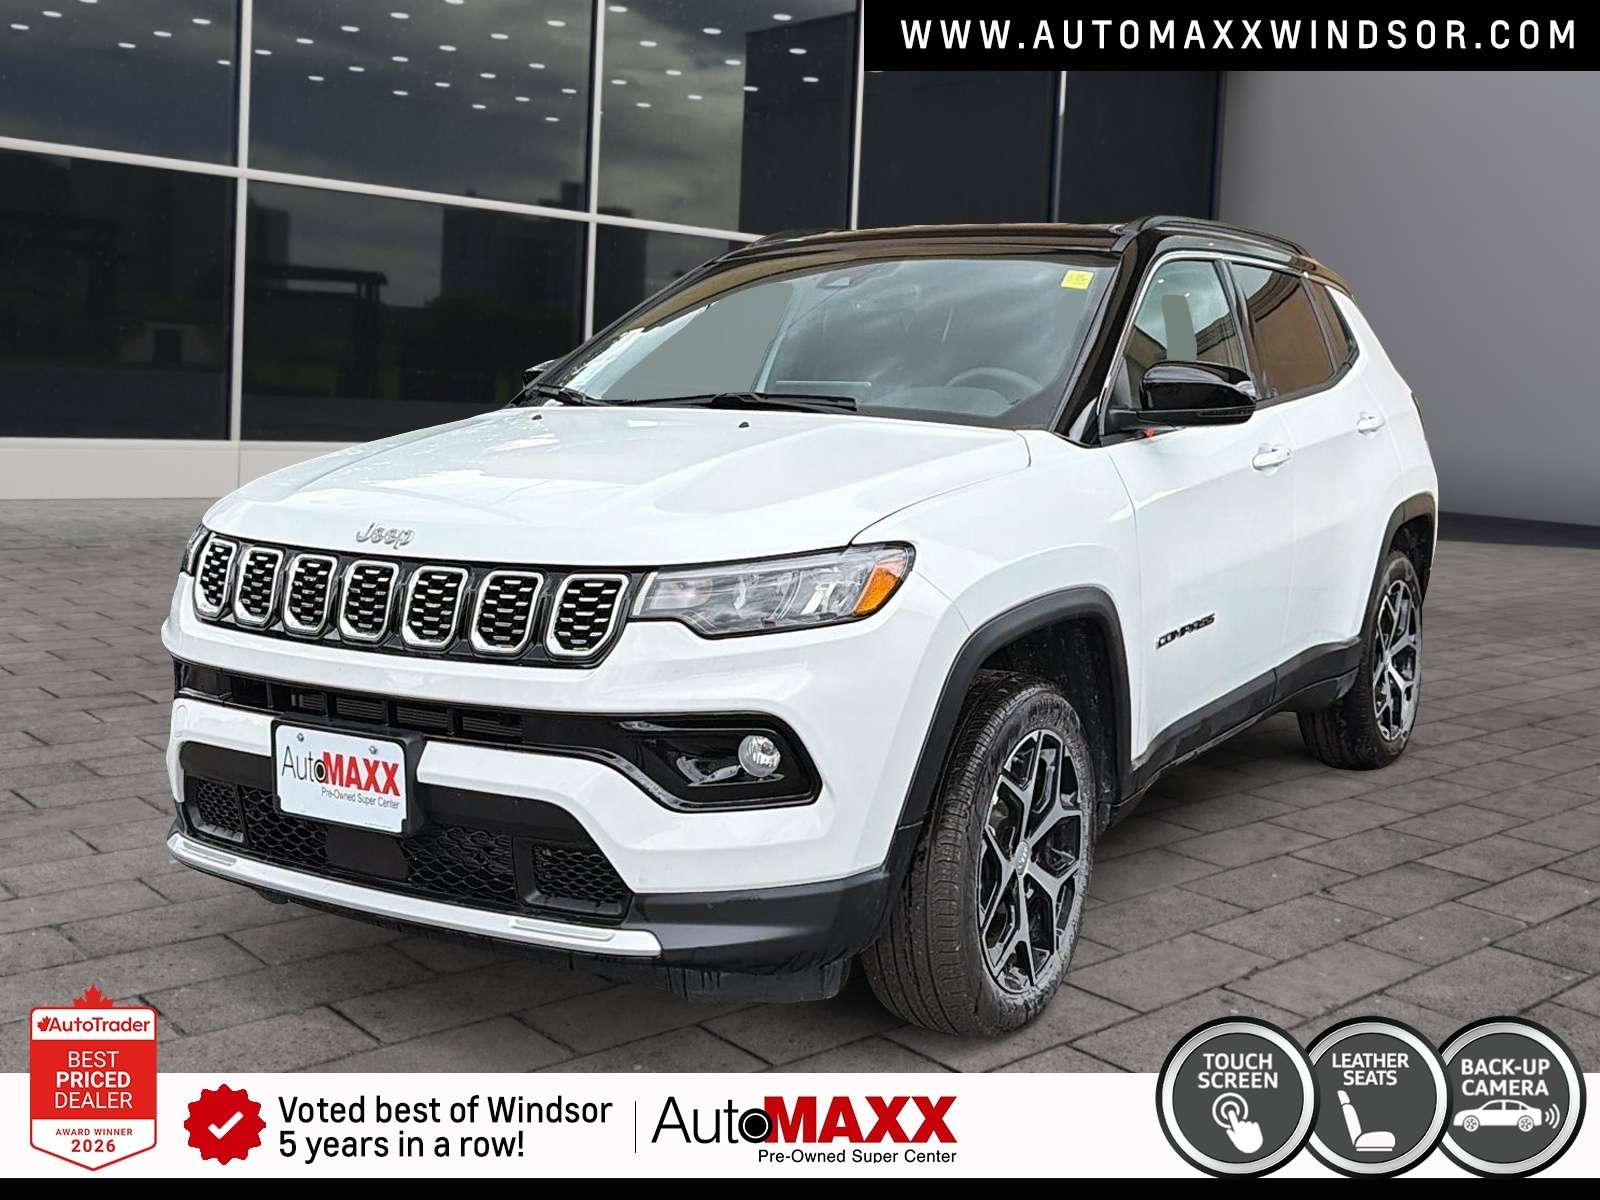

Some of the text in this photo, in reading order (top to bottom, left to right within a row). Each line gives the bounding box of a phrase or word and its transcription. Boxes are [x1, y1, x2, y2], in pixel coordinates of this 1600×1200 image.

[356, 522, 415, 549] Jeep
[282, 745, 400, 797] AutoMAXX
[321, 787, 400, 809] Pre-Owned Super Center
